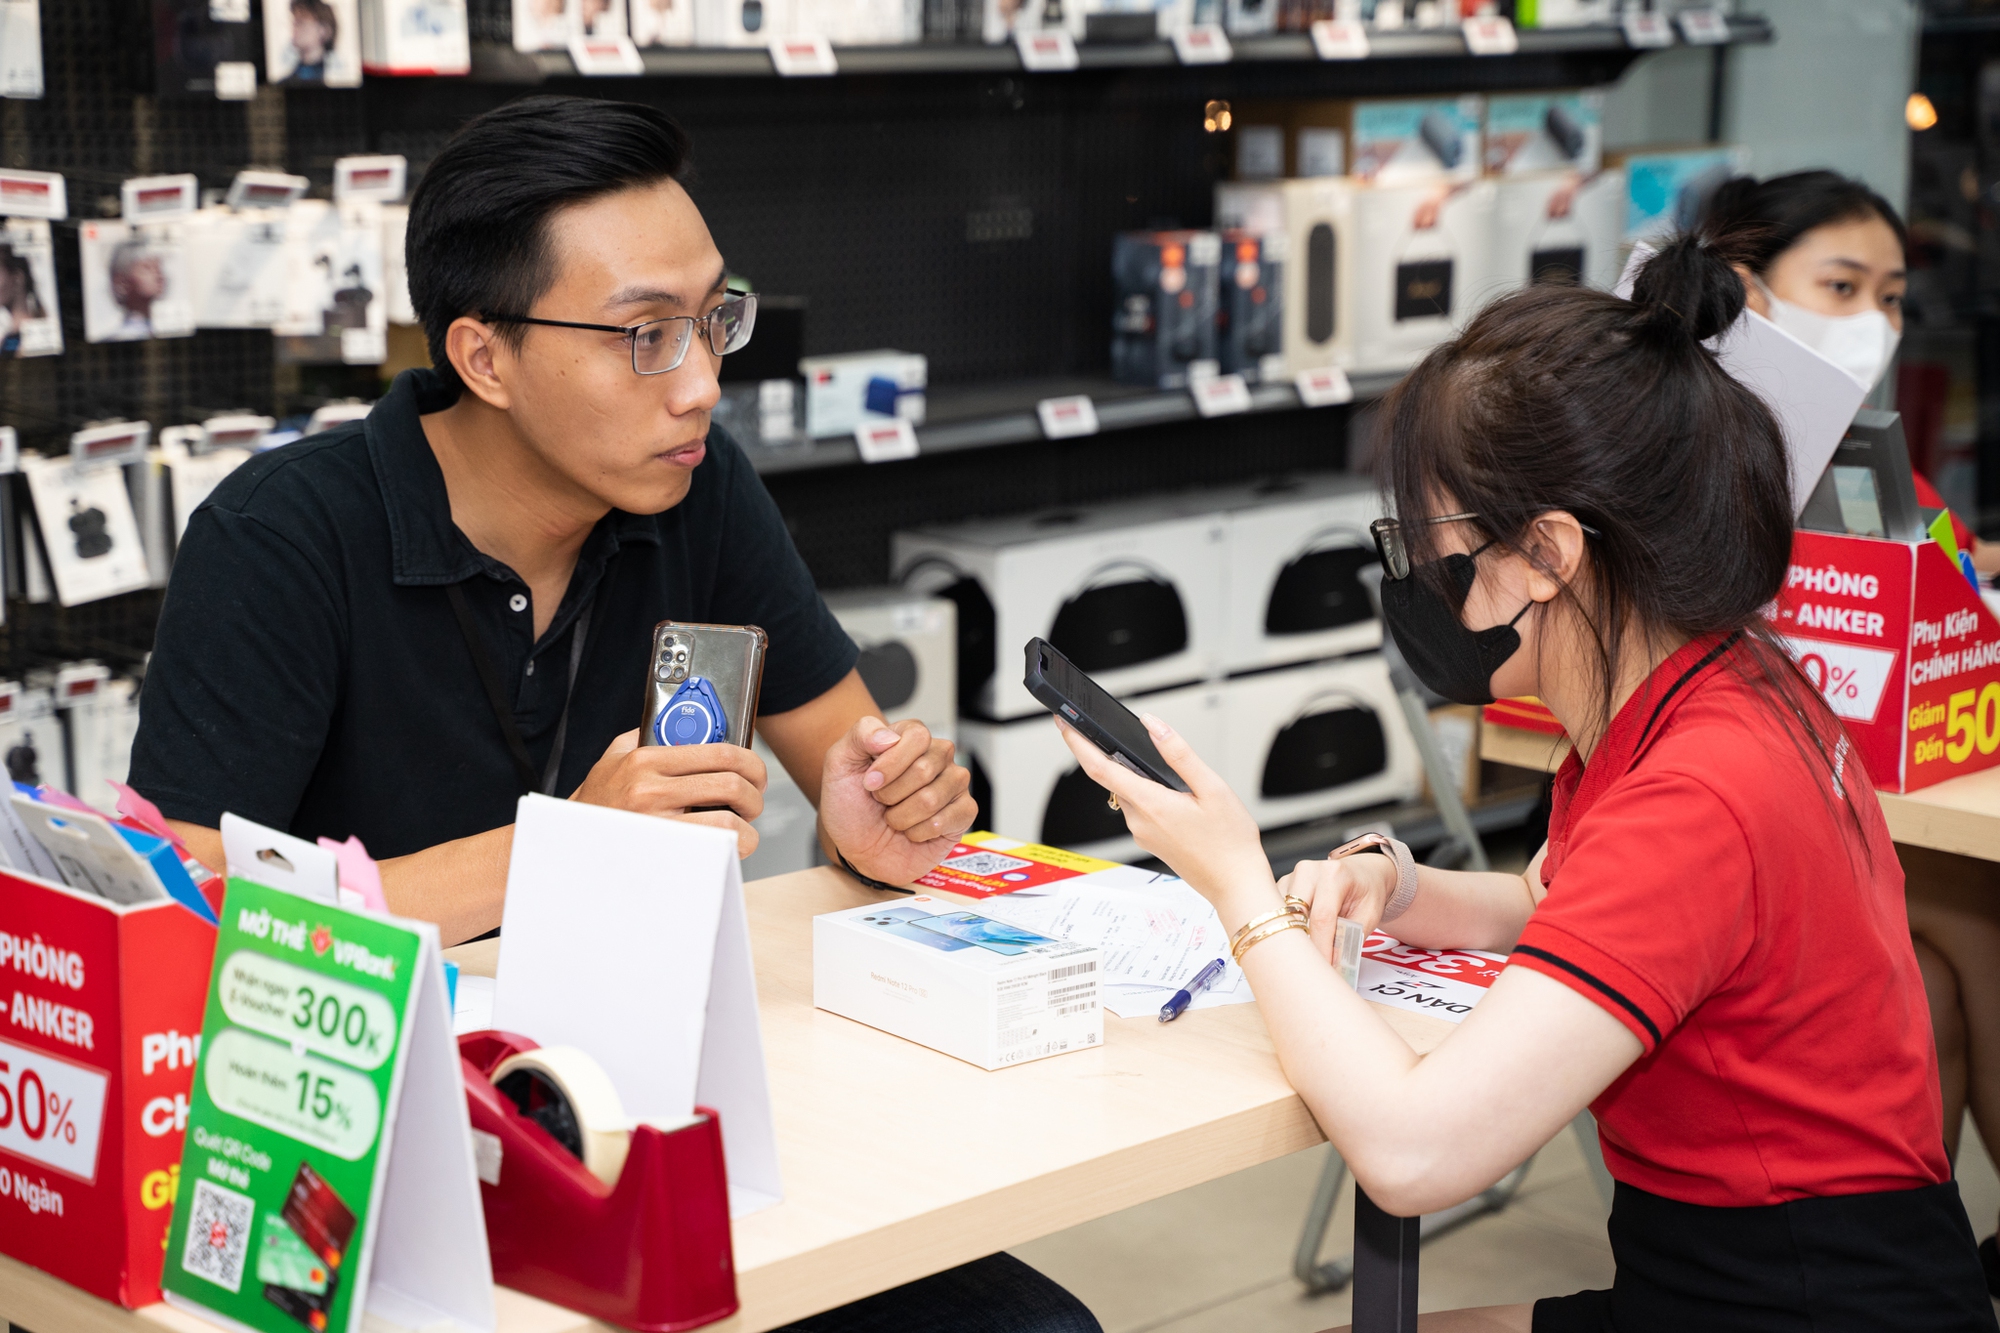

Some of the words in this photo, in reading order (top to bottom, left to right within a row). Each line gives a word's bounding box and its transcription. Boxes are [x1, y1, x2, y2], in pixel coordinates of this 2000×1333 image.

[1788, 564, 1879, 599] PHÒNG
[1797, 602, 1885, 638] ANKER
[1913, 619, 1942, 649] Phụ
[1945, 607, 1979, 642] Kiện
[1911, 650, 1960, 686] CHÍNH
[1961, 640, 2000, 673] HÃNG
[1908, 700, 1946, 732] Giảm
[1946, 681, 2000, 764] 50
[1914, 733, 1945, 765] Đến
[0, 930, 85, 991] PHÒNG
[1362, 935, 1486, 974] 350
[870, 971, 886, 983] Redmi
[887, 977, 900, 989] Note
[901, 982, 908, 992] 12
[908, 984, 918, 995] Pro
[11, 989, 95, 1052] ANKER
[1403, 992, 1473, 1014] DÁN
[13, 1170, 64, 1218] Ngàn
